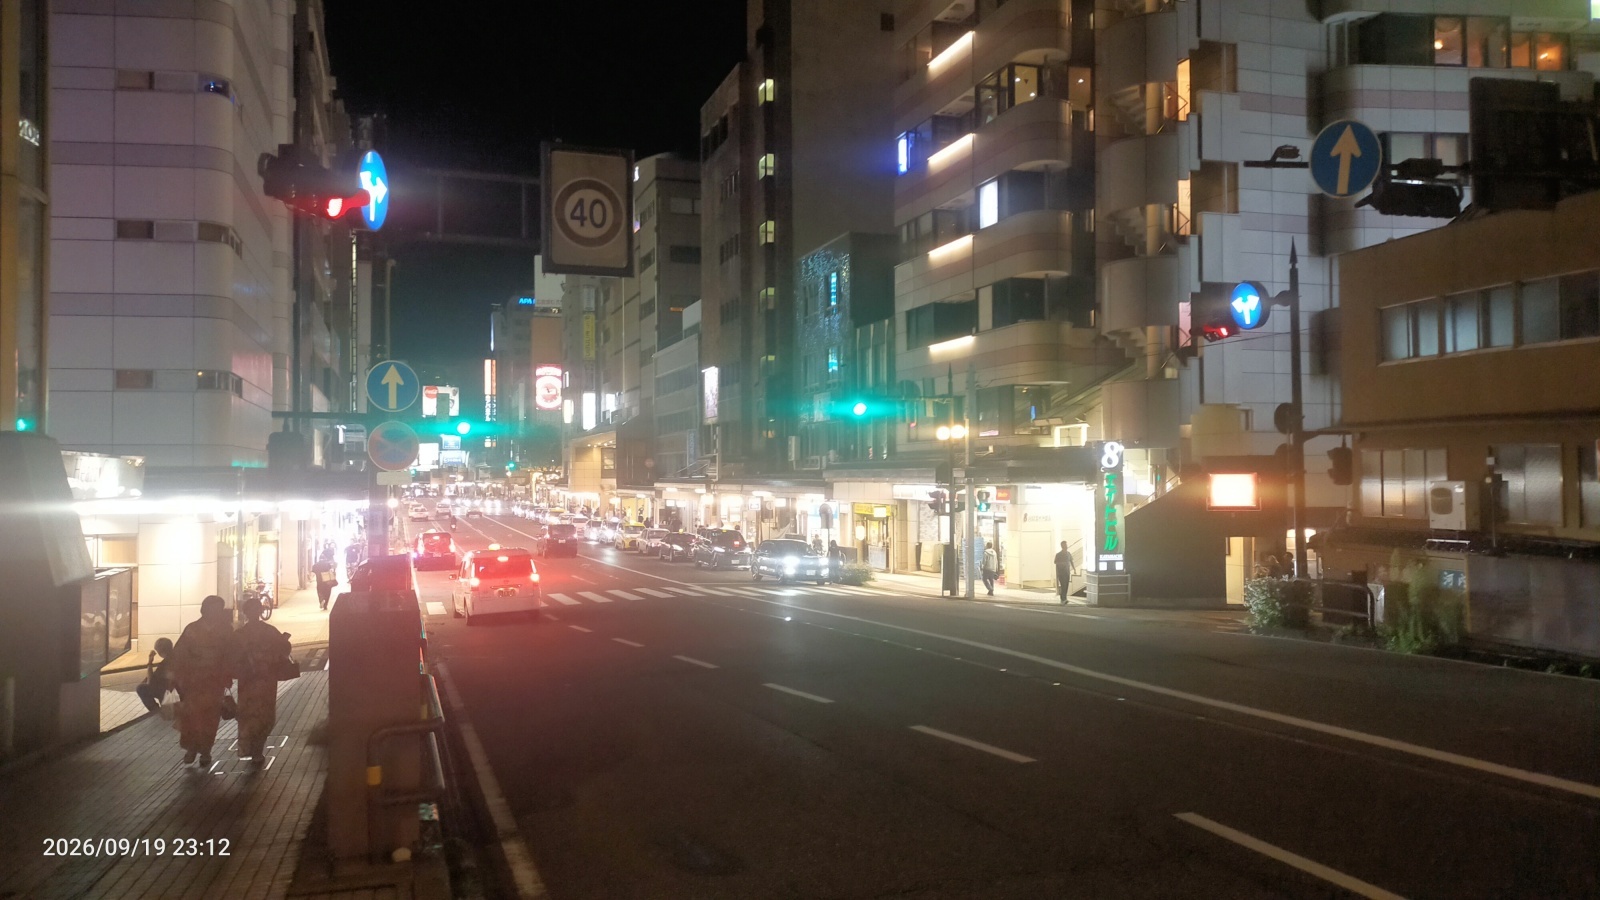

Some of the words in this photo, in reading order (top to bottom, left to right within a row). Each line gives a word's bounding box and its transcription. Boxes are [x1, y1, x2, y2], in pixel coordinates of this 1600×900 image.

[570, 197, 607, 229] 40
[518, 297, 533, 305] APA
[1101, 441, 1120, 468] 8
[1103, 472, 1118, 551] エイトビル
